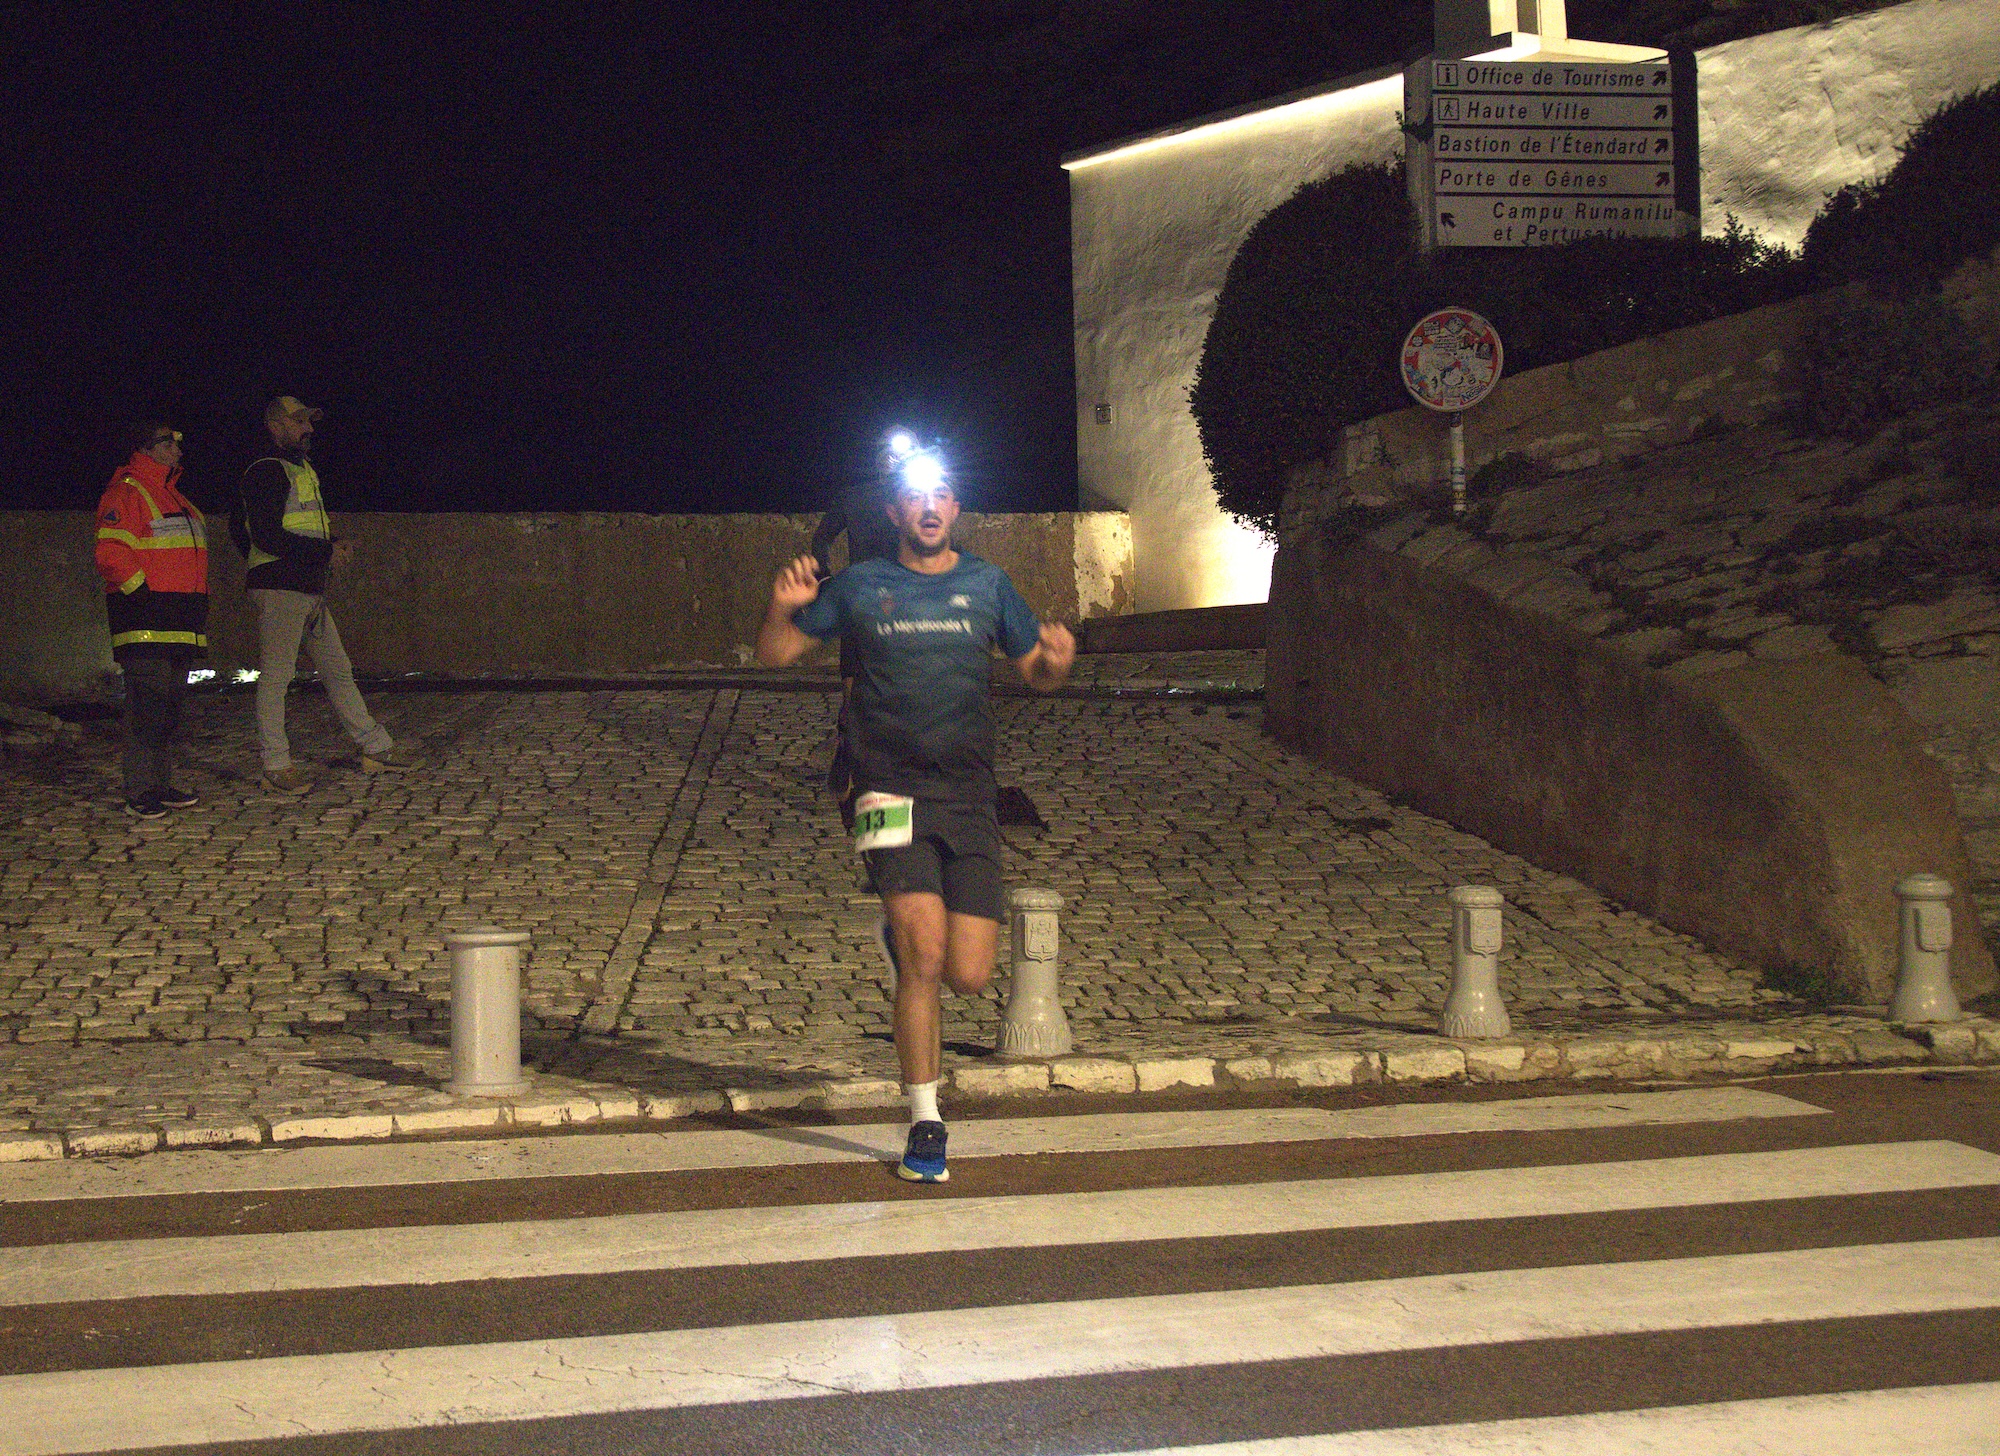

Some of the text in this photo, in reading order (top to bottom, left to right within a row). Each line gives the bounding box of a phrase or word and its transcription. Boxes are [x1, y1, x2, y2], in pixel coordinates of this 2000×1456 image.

[1466, 67, 1645, 87] Office de Tourisme
[1467, 102, 1590, 120] Haute Ville
[1439, 134, 1648, 154] Bastion de l'Étendard
[1440, 170, 1608, 188] Porte de Gênes
[1492, 202, 1674, 222] Campu Rumanilu
[1494, 224, 1627, 242] et Pertusatu
